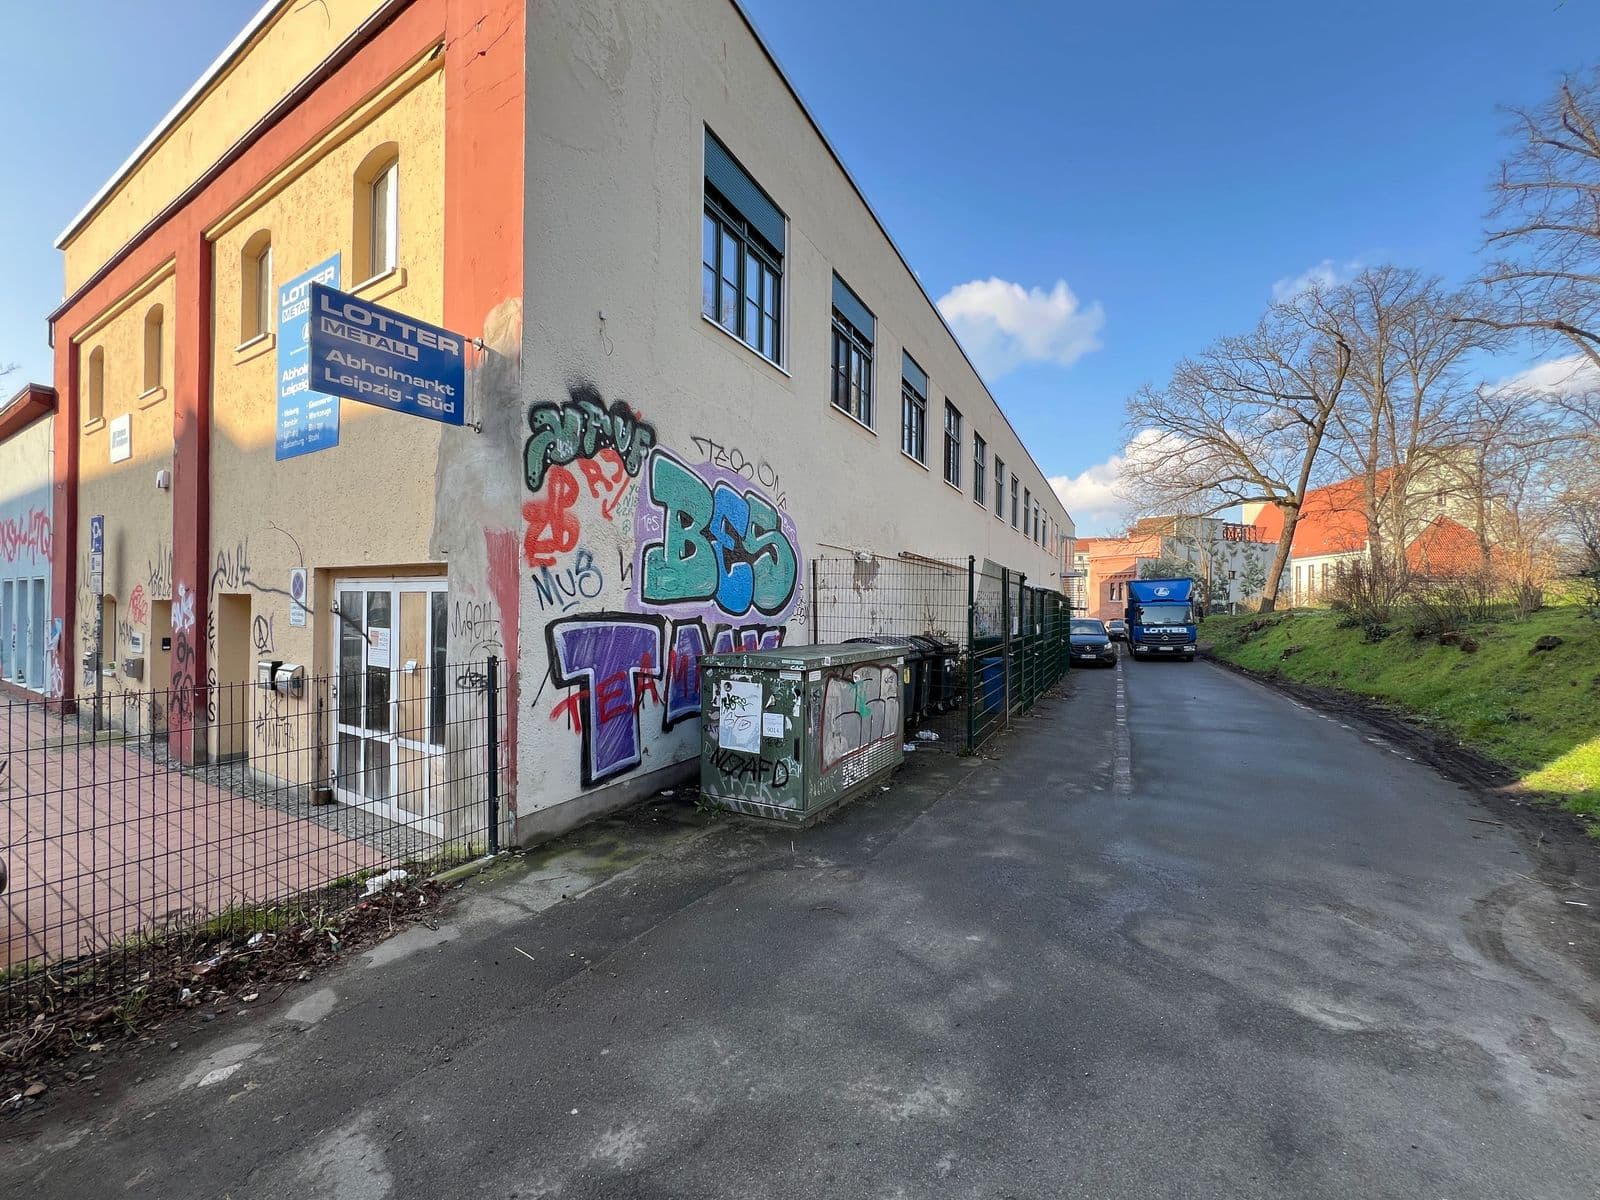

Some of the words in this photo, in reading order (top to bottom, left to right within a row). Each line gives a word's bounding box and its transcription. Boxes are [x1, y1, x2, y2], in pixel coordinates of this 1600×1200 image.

[282, 300, 310, 322] METAL
[321, 294, 459, 356] LOTTER
[322, 317, 417, 360] METALL
[325, 367, 402, 402] Leipzig
[417, 392, 455, 413] Süd
[326, 349, 455, 396] Abholmarkt
